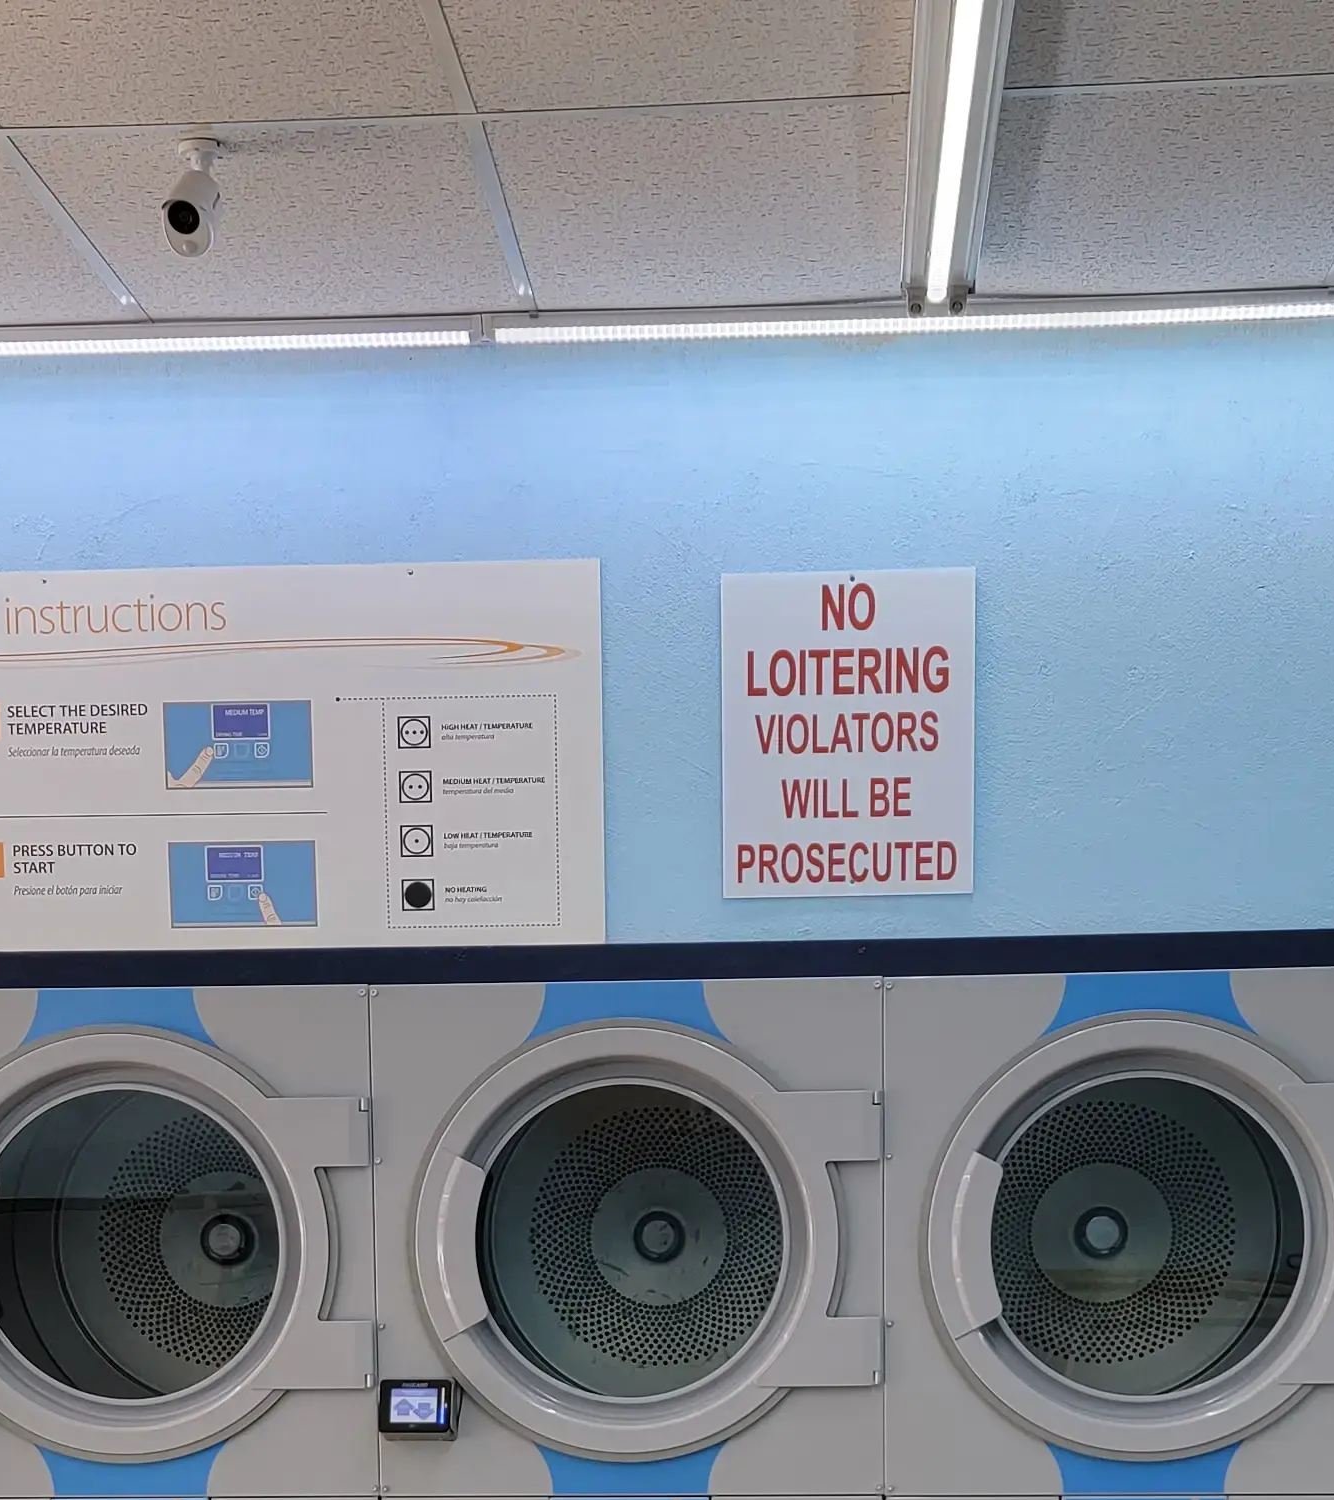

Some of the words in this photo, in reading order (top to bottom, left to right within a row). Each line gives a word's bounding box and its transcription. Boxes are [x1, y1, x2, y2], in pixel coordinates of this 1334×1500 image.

[5, 593, 227, 635] instructions
[821, 583, 876, 631] NO
[746, 645, 950, 697] LOITERING
[7, 705, 56, 718] SELECT
[60, 704, 86, 717] THE
[90, 703, 148, 716] DESIRED
[7, 721, 107, 735] TEMPERATURE
[483, 722, 533, 730] TEMPERATURE
[754, 711, 940, 755] VIOLATORS
[8, 746, 49, 758] Seleccionar
[52, 746, 60, 757] la
[60, 745, 107, 758] temperatura
[109, 745, 140, 756] deseada
[496, 776, 545, 784] TEMPERATURE
[781, 778, 860, 819] WILL
[869, 776, 912, 817] BE
[12, 844, 53, 857] PRESS
[57, 844, 114, 857] BUTTON
[118, 843, 137, 856] TO
[13, 861, 55, 874] START
[736, 840, 958, 884] PROSECUTED
[13, 885, 45, 896] Presione
[47, 885, 54, 895] el
[79, 886, 97, 897] para
[99, 885, 122, 895] iniciar
